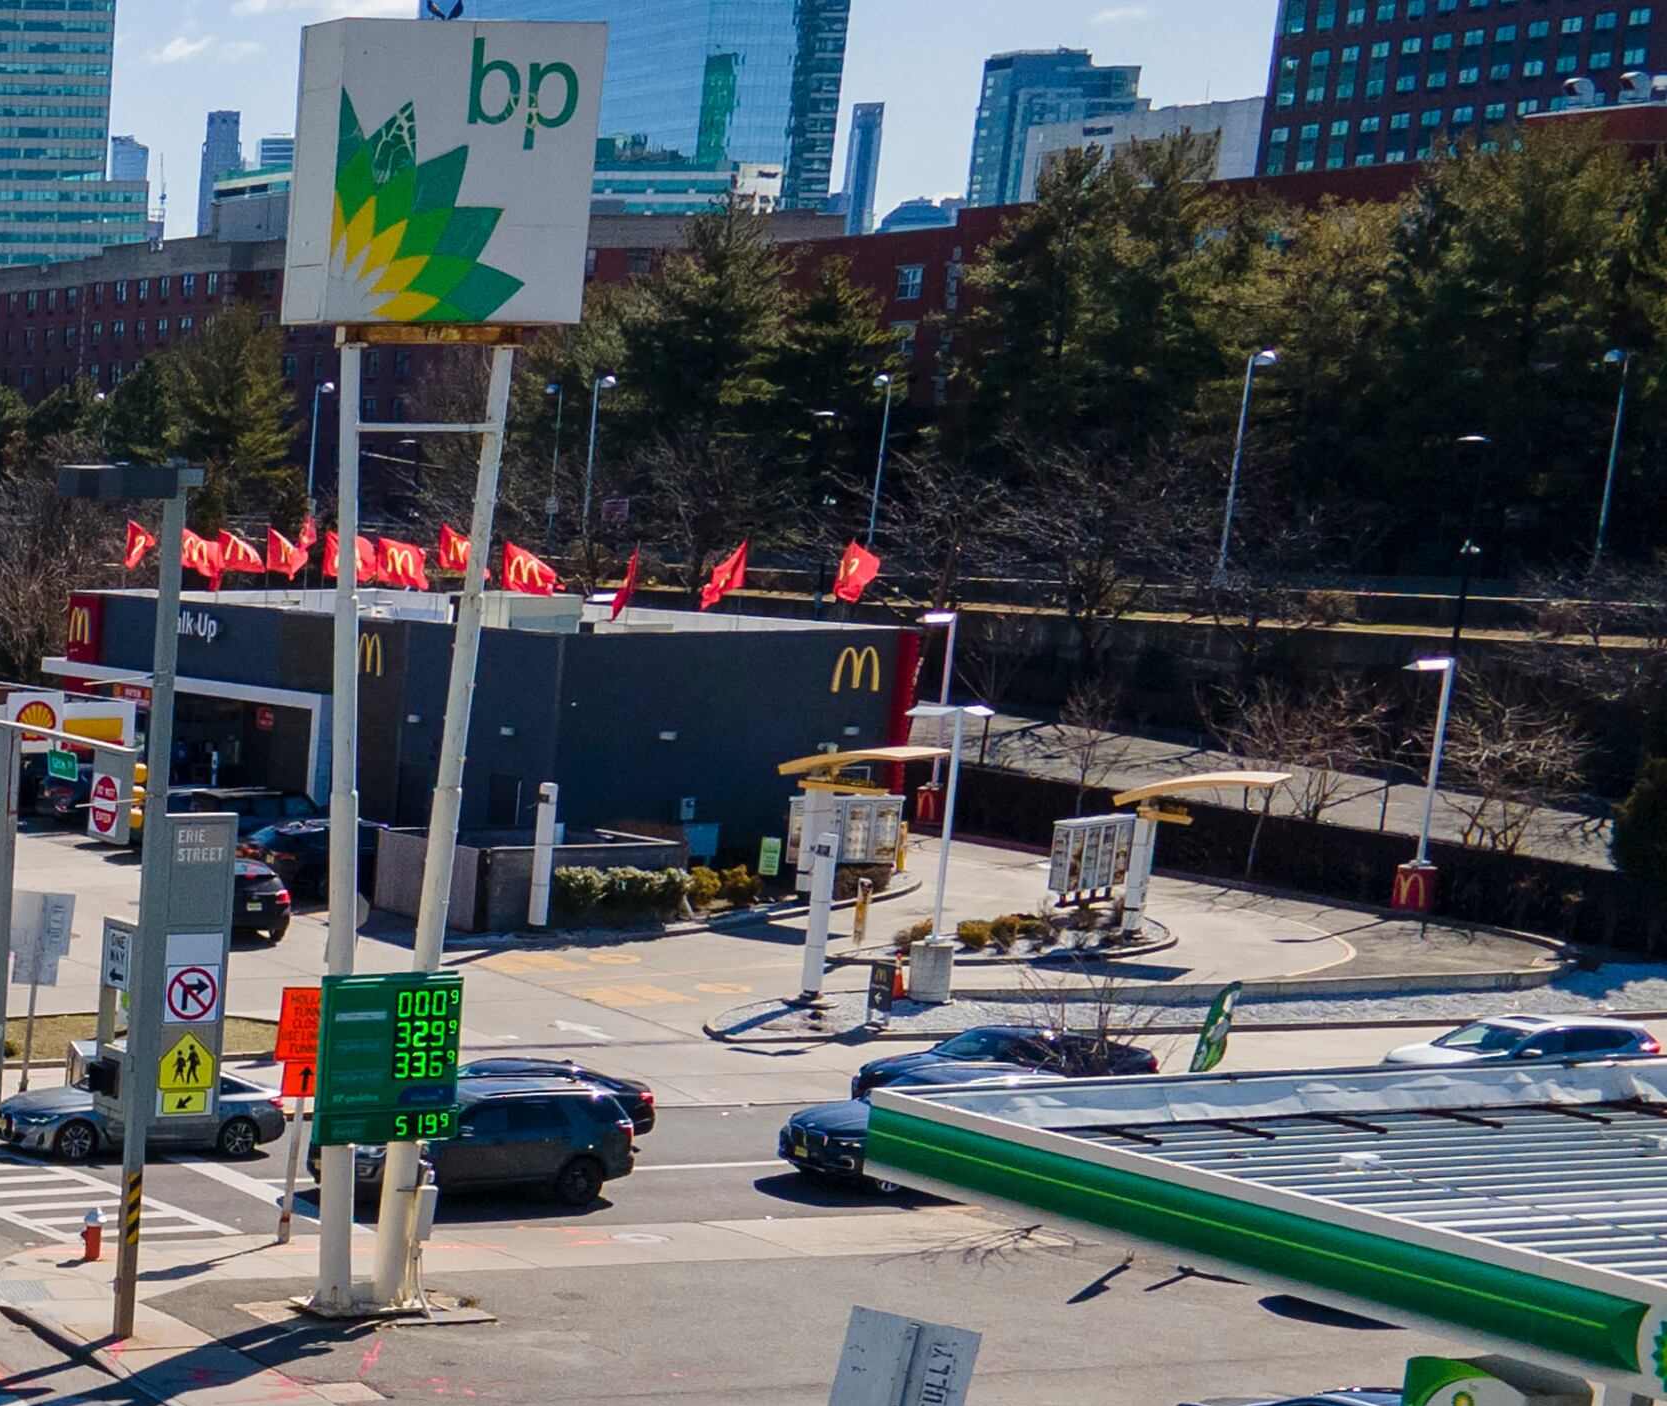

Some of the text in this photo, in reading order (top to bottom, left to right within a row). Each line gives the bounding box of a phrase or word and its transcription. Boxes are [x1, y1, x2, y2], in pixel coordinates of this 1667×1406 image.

[467, 37, 579, 150] bp
[177, 611, 218, 643] alk Up
[178, 829, 205, 843] ERIE
[178, 847, 224, 862] STREET
[111, 933, 127, 949] ONE
